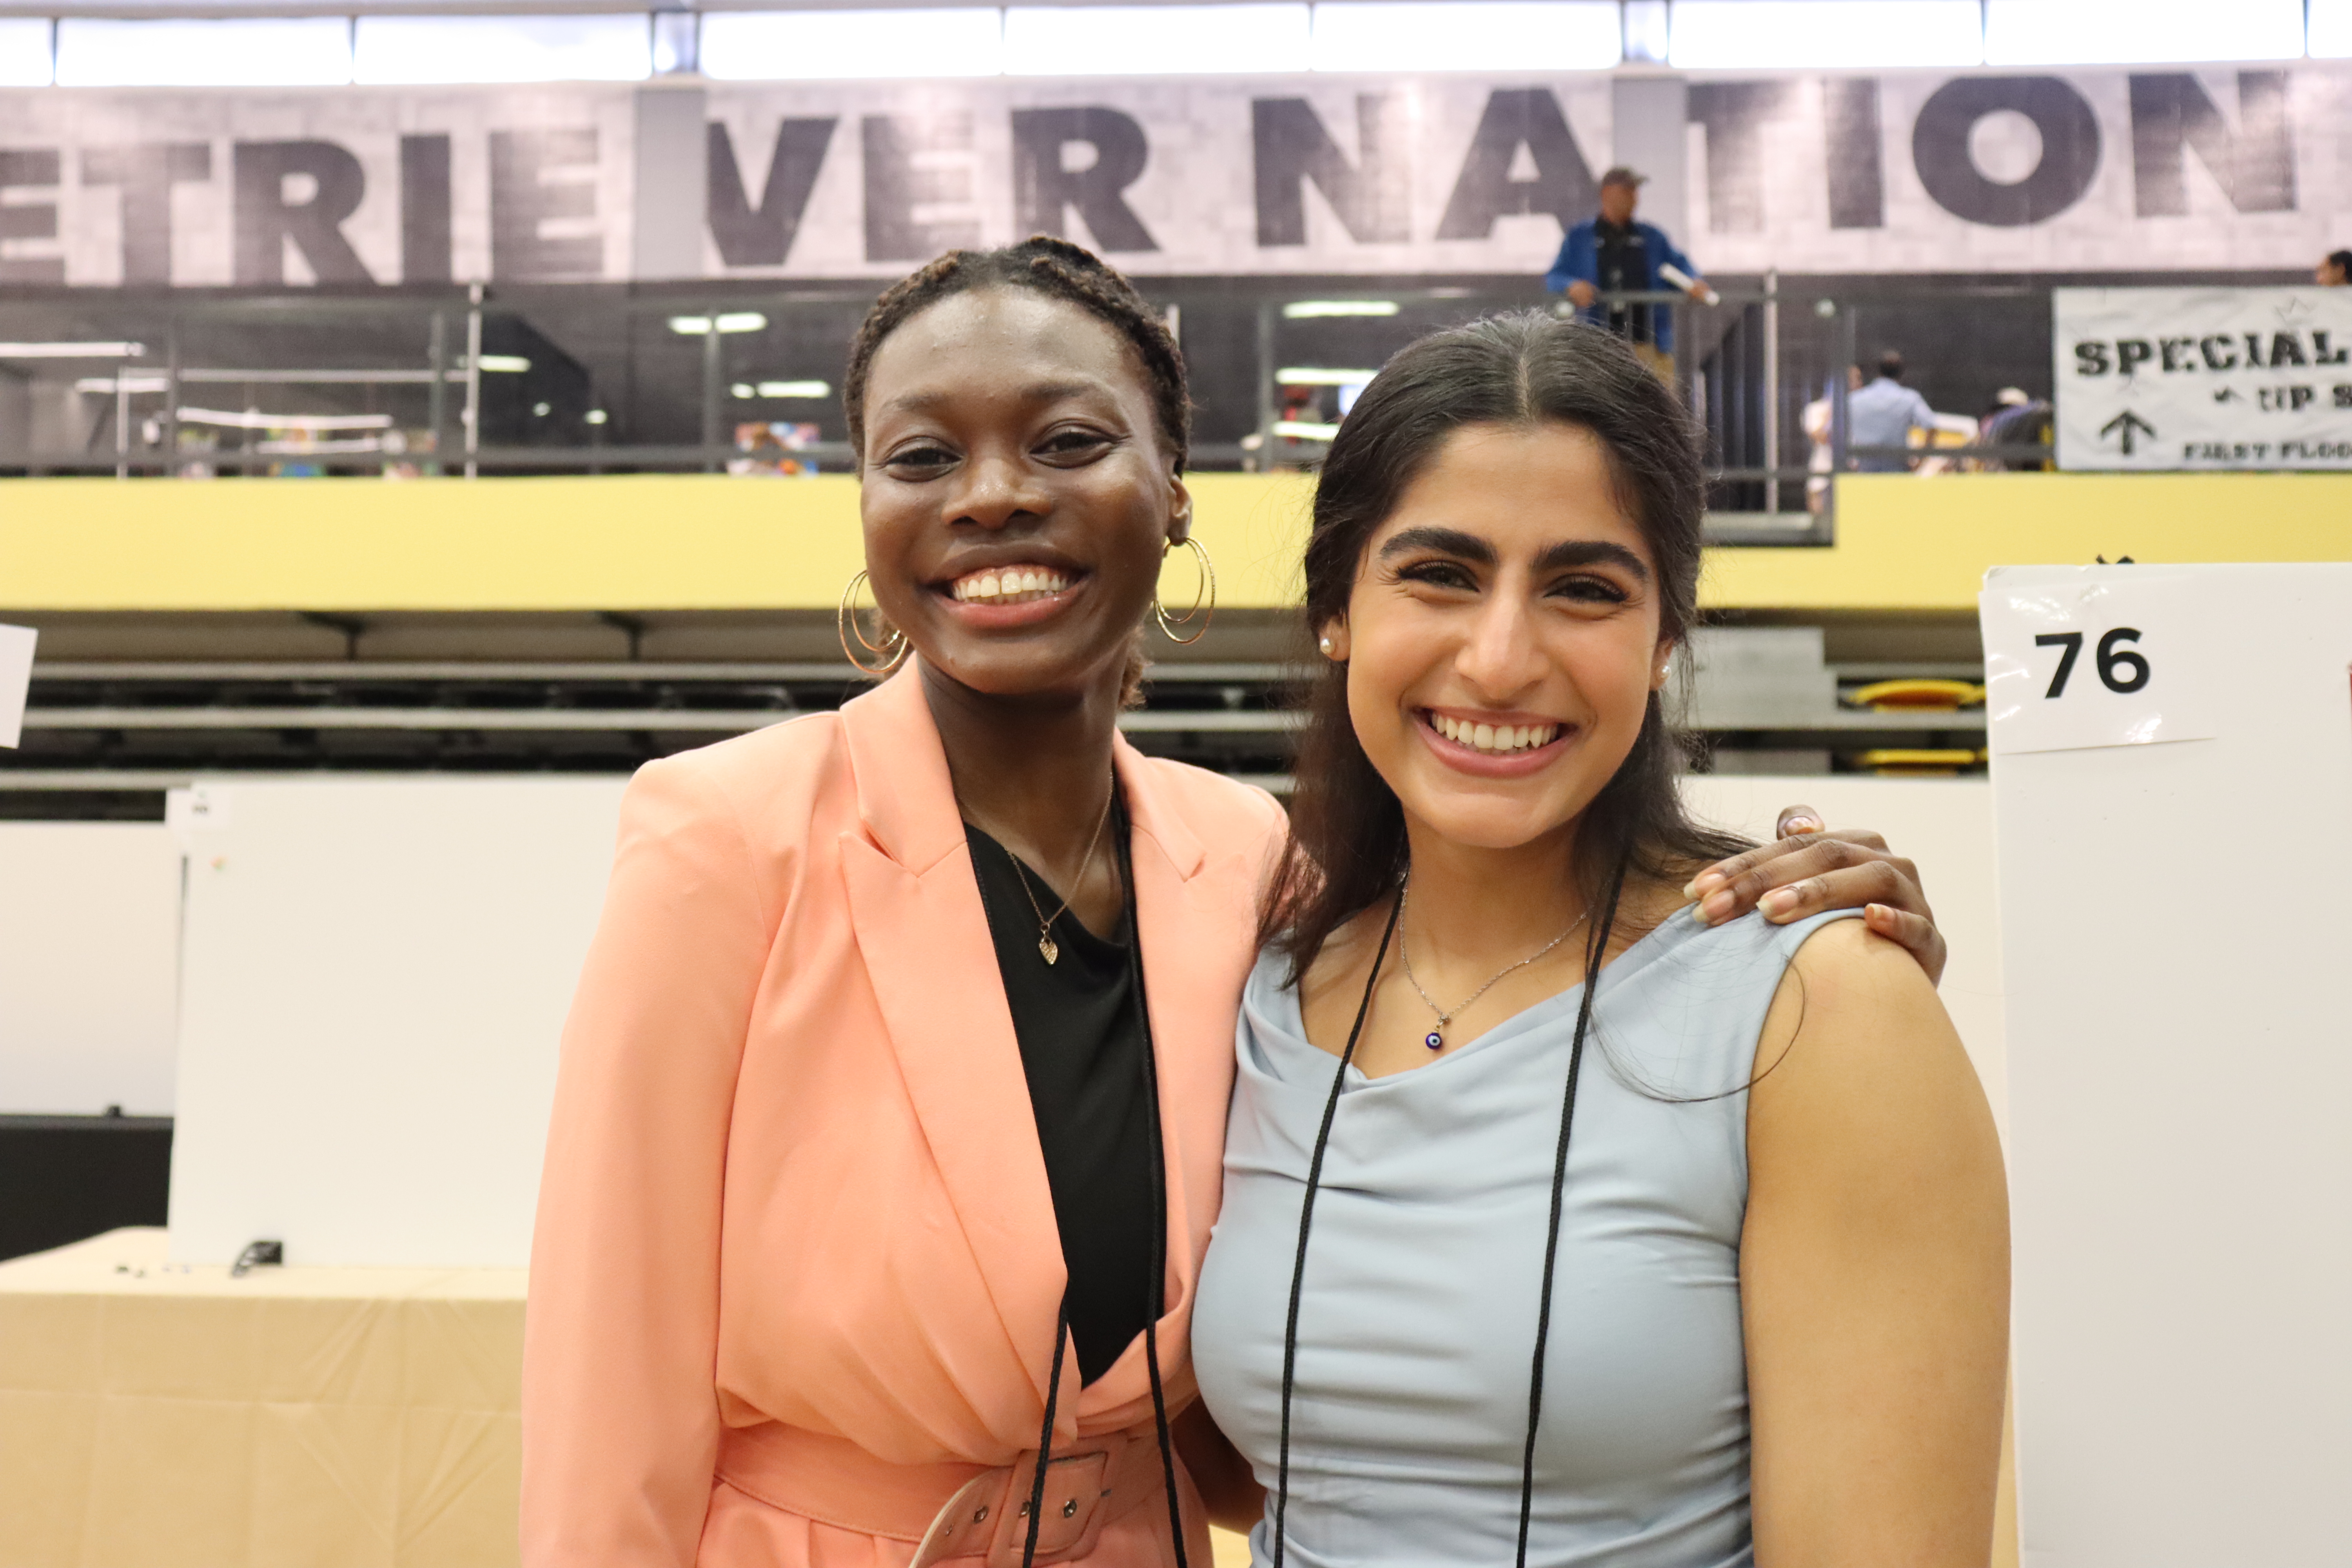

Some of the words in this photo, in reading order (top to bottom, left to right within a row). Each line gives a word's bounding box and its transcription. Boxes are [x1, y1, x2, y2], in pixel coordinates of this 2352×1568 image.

[1252, 71, 2298, 247] NATION
[2074, 330, 2348, 376] SPECIAL
[2035, 628, 2150, 699] 76
